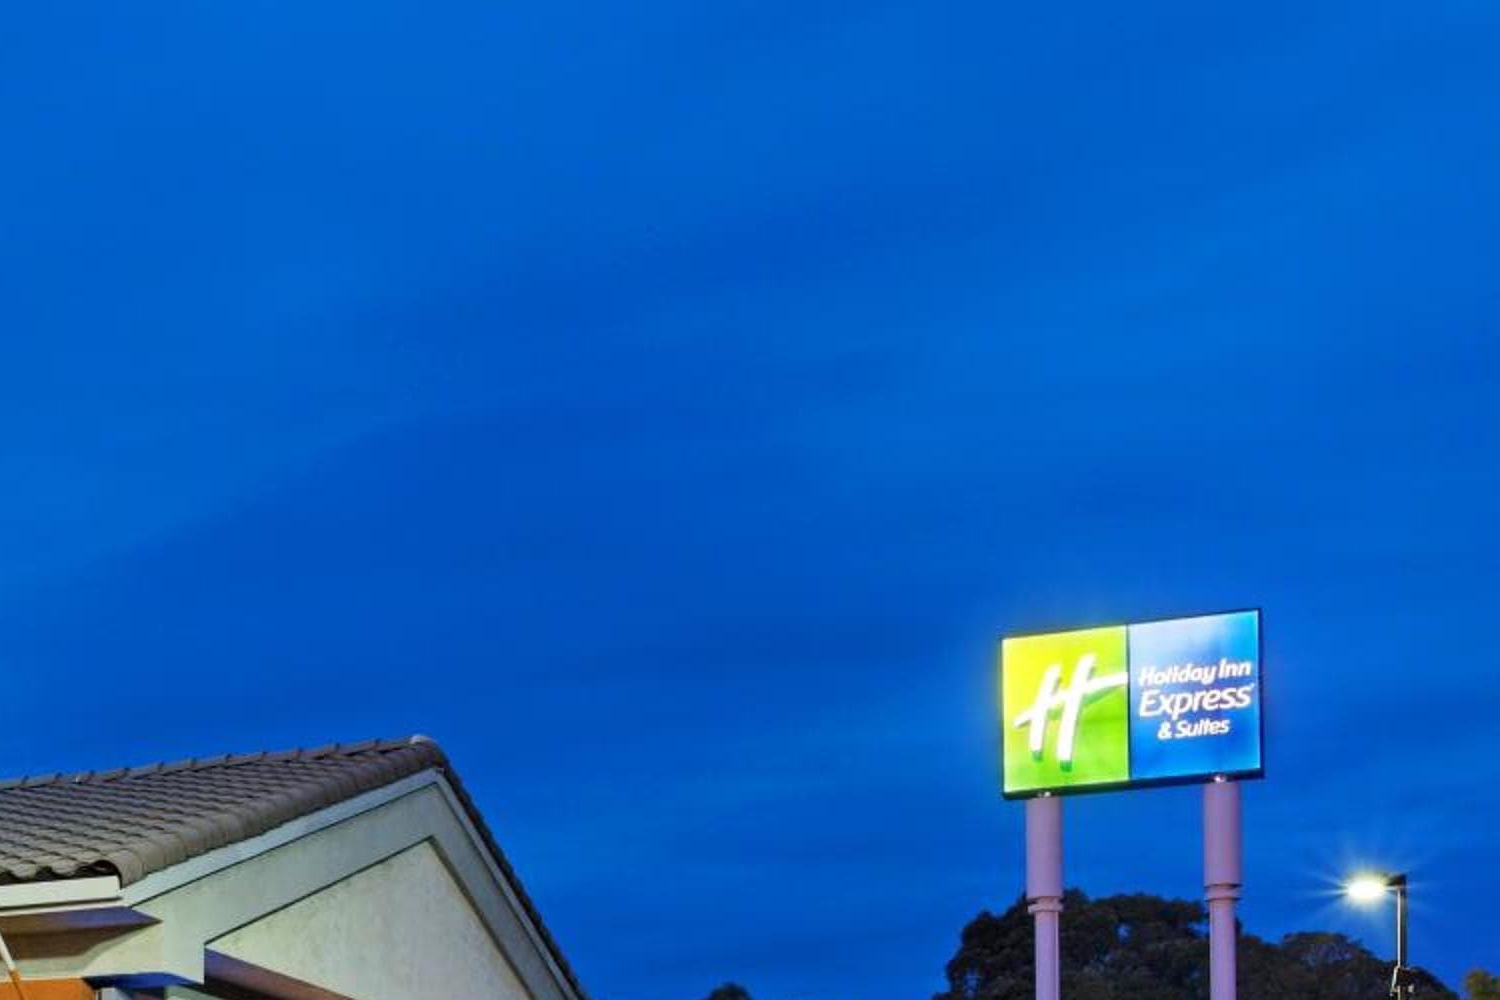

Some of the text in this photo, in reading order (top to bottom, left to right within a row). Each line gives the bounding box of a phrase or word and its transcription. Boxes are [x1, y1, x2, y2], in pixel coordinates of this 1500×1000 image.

[1139, 658, 1252, 685] Holiday Inn
[1139, 686, 1252, 720] Express
[1157, 718, 1231, 739] & Suites
